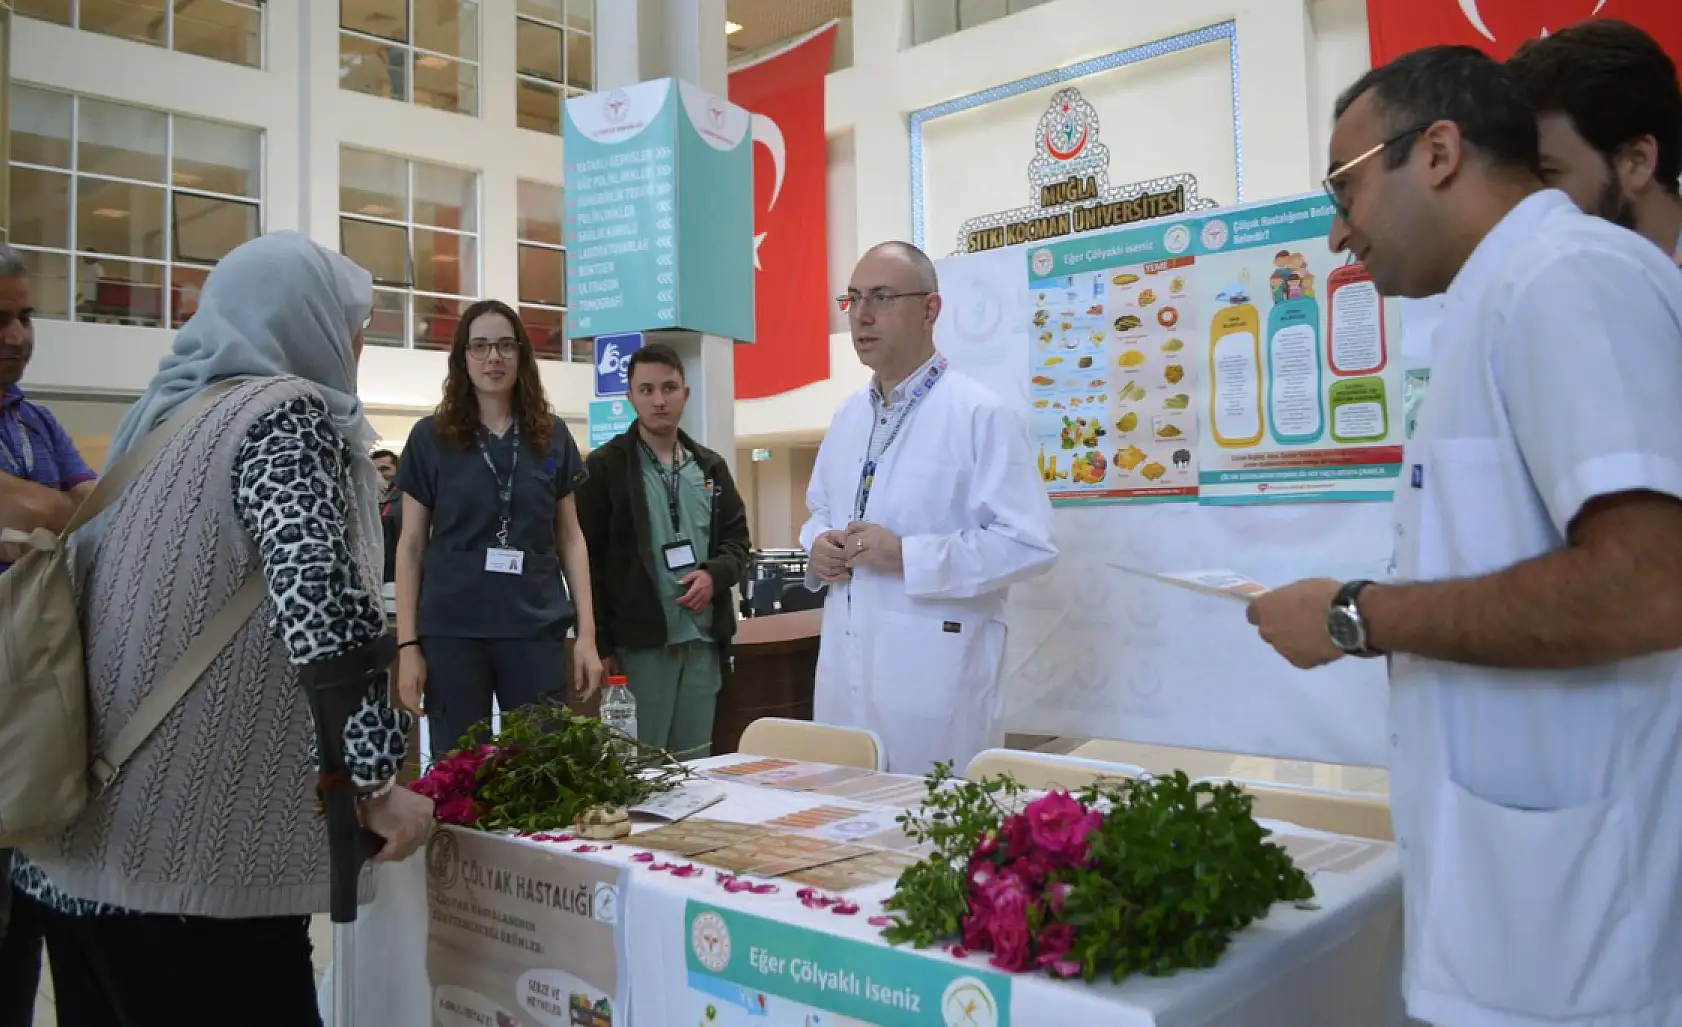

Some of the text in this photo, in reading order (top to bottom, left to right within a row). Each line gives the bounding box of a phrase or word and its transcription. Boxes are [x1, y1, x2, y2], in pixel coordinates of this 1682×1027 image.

[1041, 176, 1098, 207] MUĞLA
[967, 184, 1186, 252] SITKI KOÇMAN ÜNİVERSİTESİ
[1064, 252, 1084, 266] Eğer
[1086, 245, 1124, 262] Çölyaklı
[461, 860, 594, 919] ÇÖLYAK HASTALIĞI
[528, 978, 551, 996] SEBZE
[750, 946, 785, 975] Eğer
[790, 957, 861, 993] Çölyaklı
